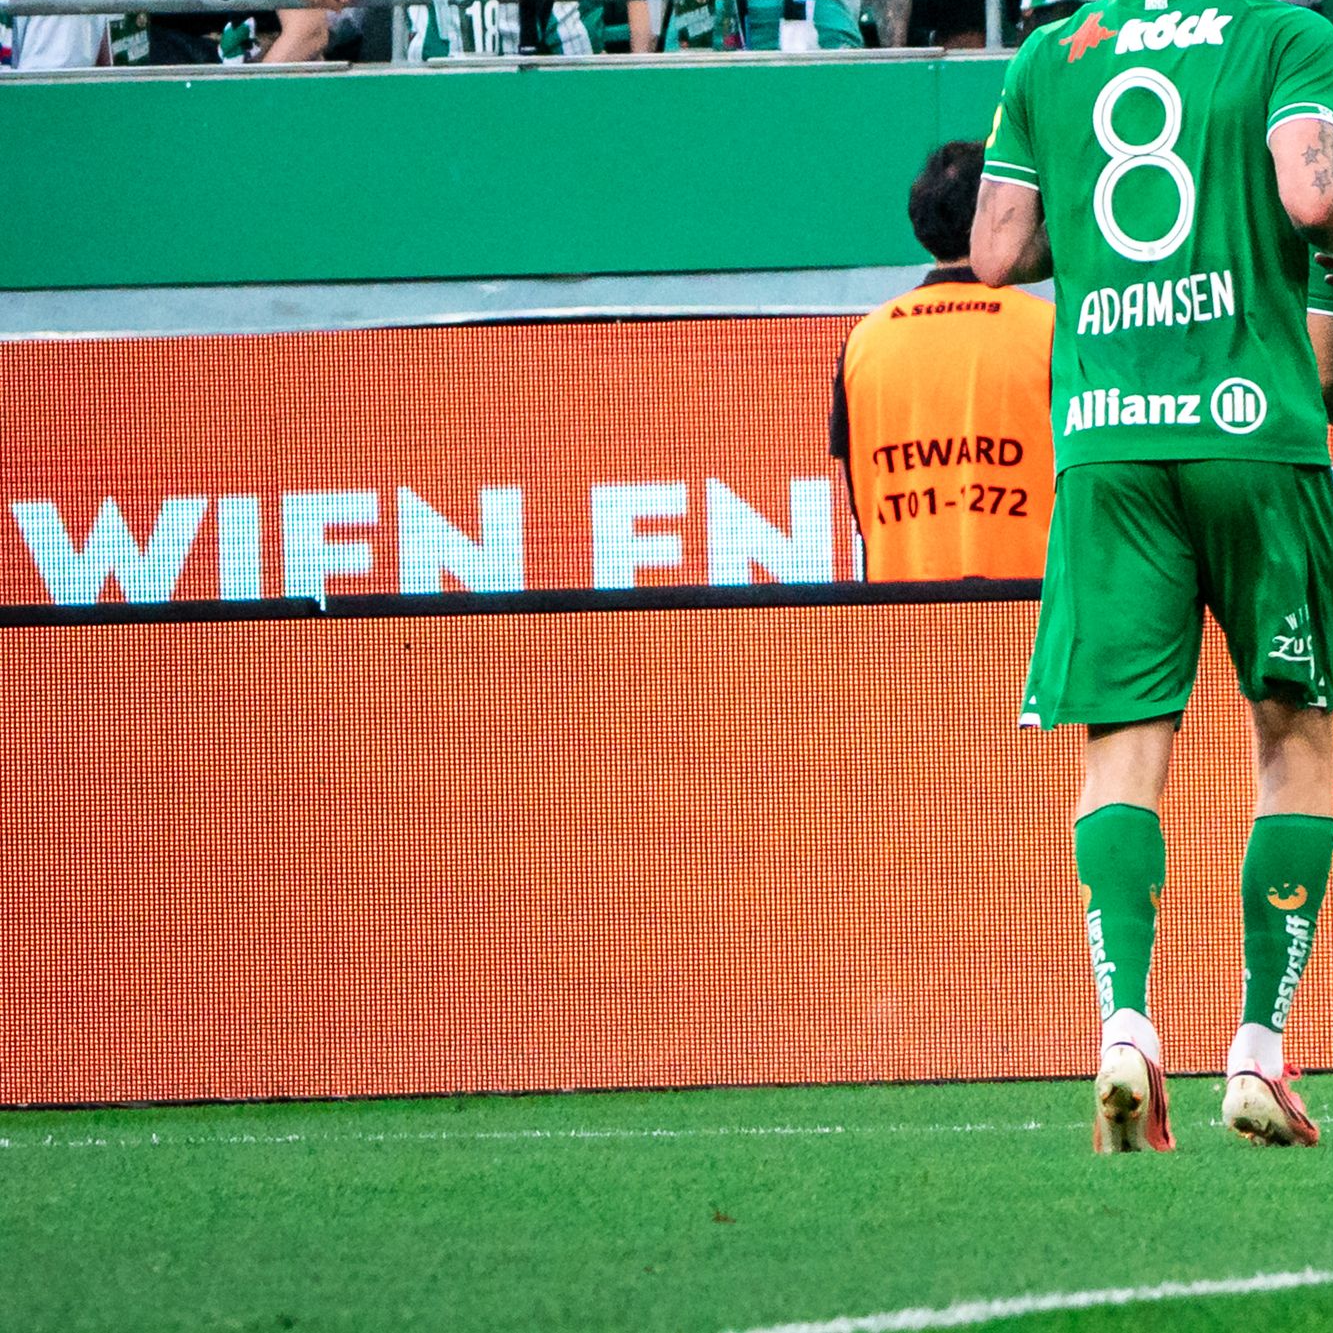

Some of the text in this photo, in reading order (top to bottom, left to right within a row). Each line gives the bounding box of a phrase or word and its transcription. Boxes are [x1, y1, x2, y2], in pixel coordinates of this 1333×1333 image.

[1092, 67, 1196, 262] 8
[1077, 270, 1236, 336] ADAMSEN
[1064, 389, 1201, 436] Allianz
[873, 435, 1024, 473] TEWARD
